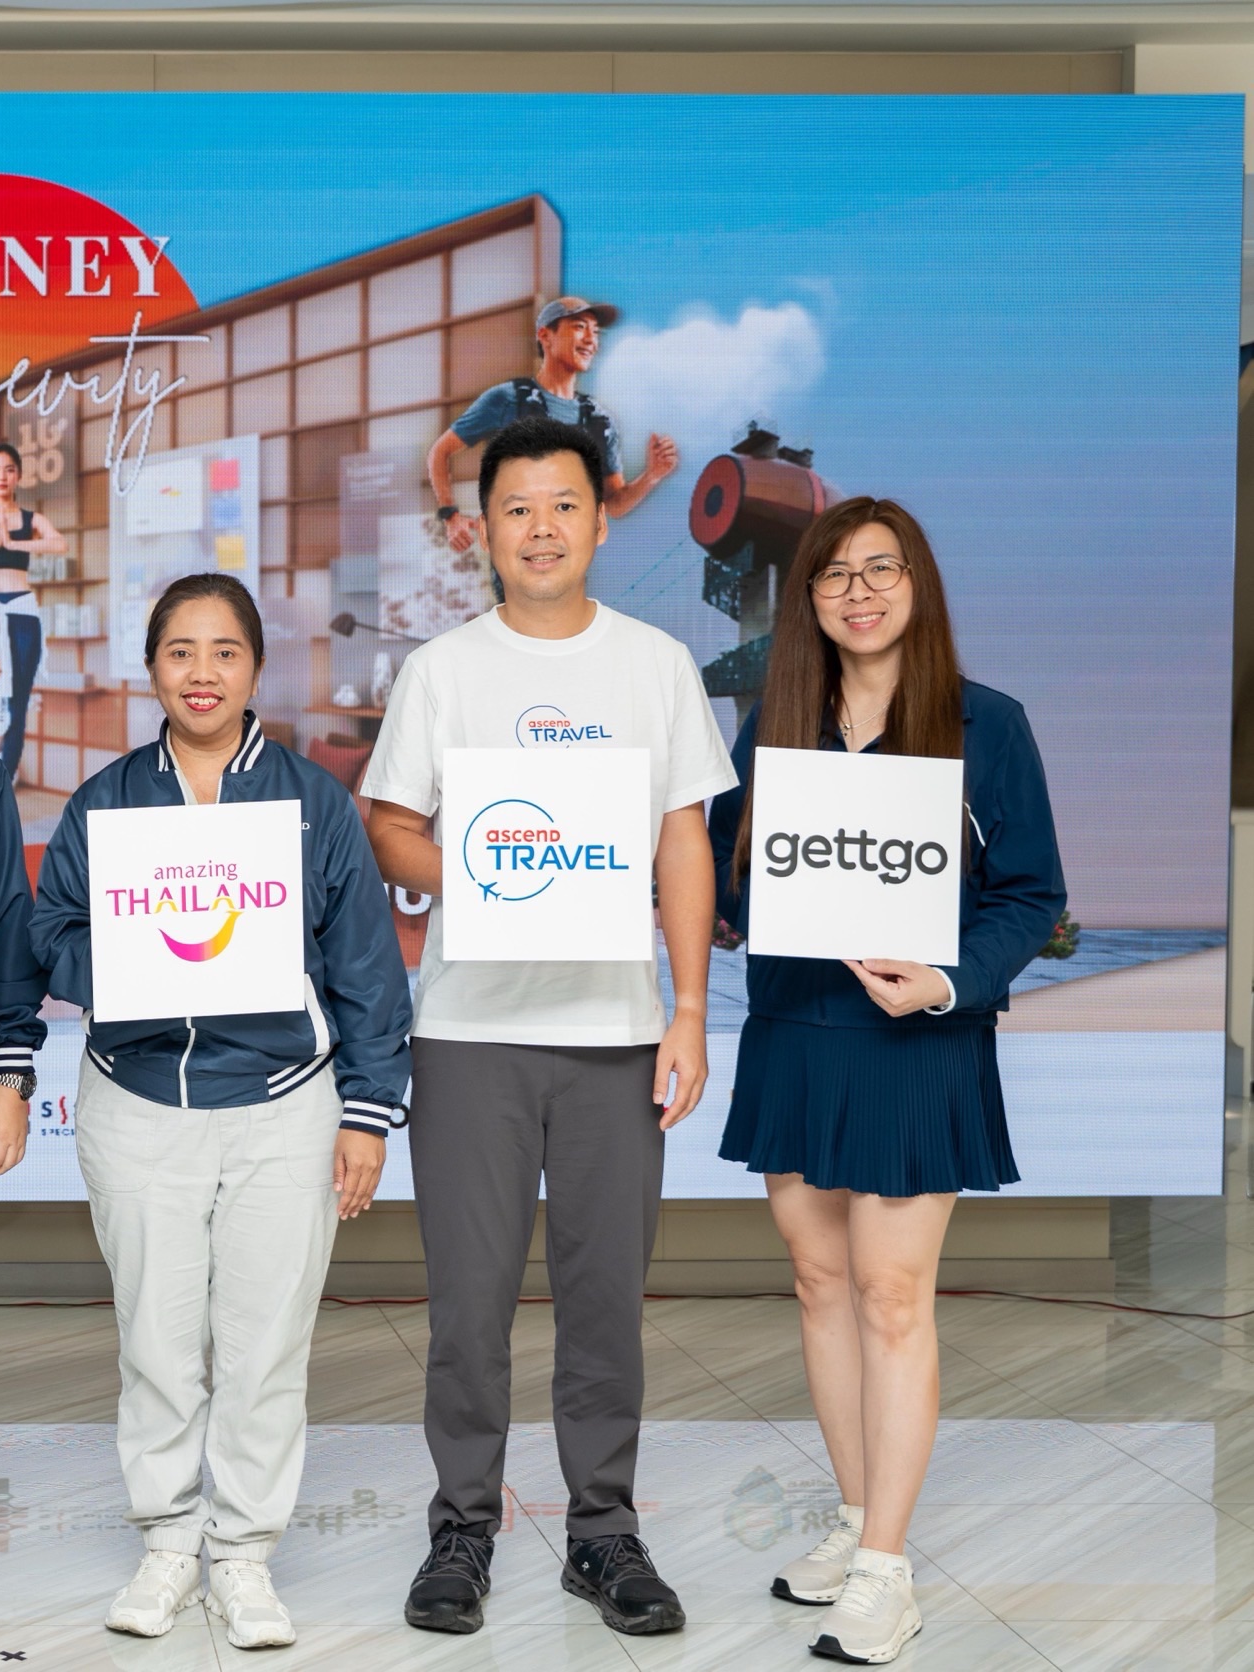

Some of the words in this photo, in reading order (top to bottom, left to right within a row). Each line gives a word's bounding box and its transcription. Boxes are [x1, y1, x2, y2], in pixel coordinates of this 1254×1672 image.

[528, 725, 613, 742] TRAVEL
[486, 844, 630, 870] TRAVEL
[764, 827, 949, 885] gettgo
[154, 859, 238, 881] amazing
[105, 880, 288, 917] THAILAND
